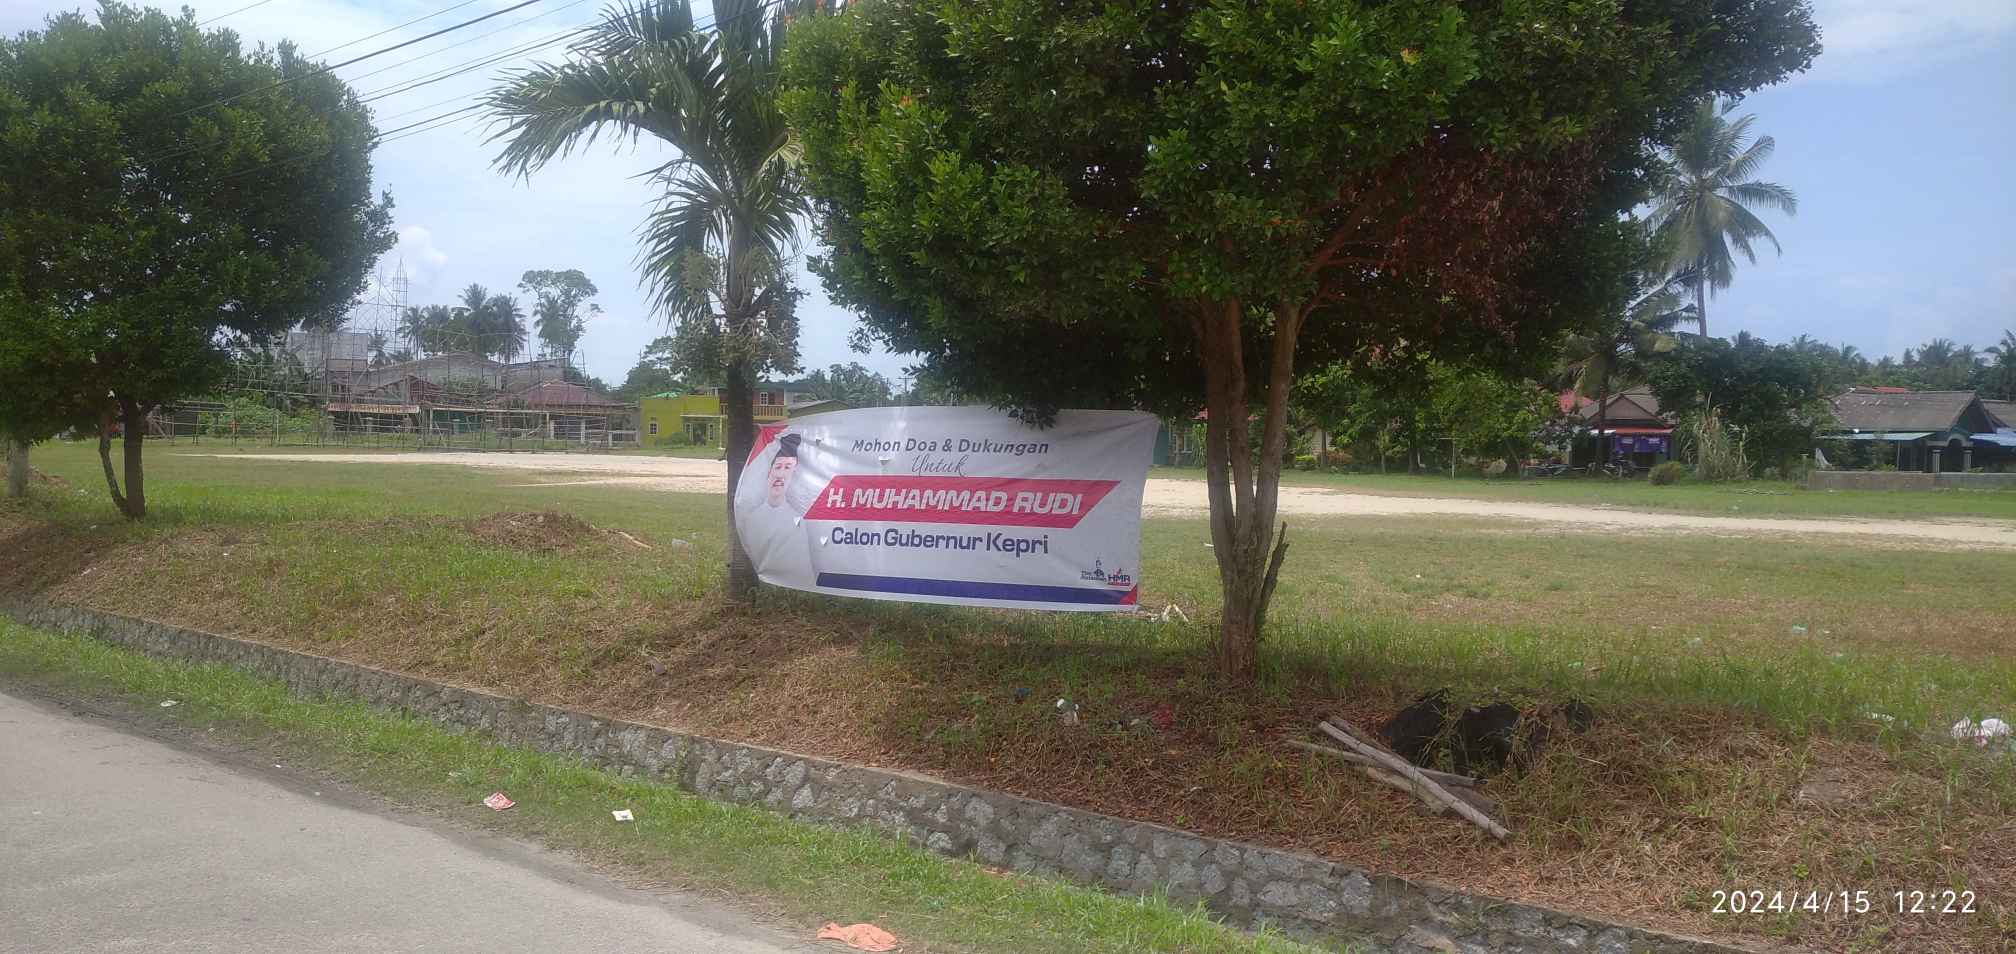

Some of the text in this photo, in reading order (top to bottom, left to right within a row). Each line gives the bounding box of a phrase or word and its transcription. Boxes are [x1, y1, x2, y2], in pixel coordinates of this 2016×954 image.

[852, 438, 1049, 457] Mohon Doa & Dukungan
[911, 454, 969, 477] Untuk
[826, 487, 1083, 515] H. MUHAMMAD RUDI
[831, 527, 1049, 558] Calon Gubernur Kepri
